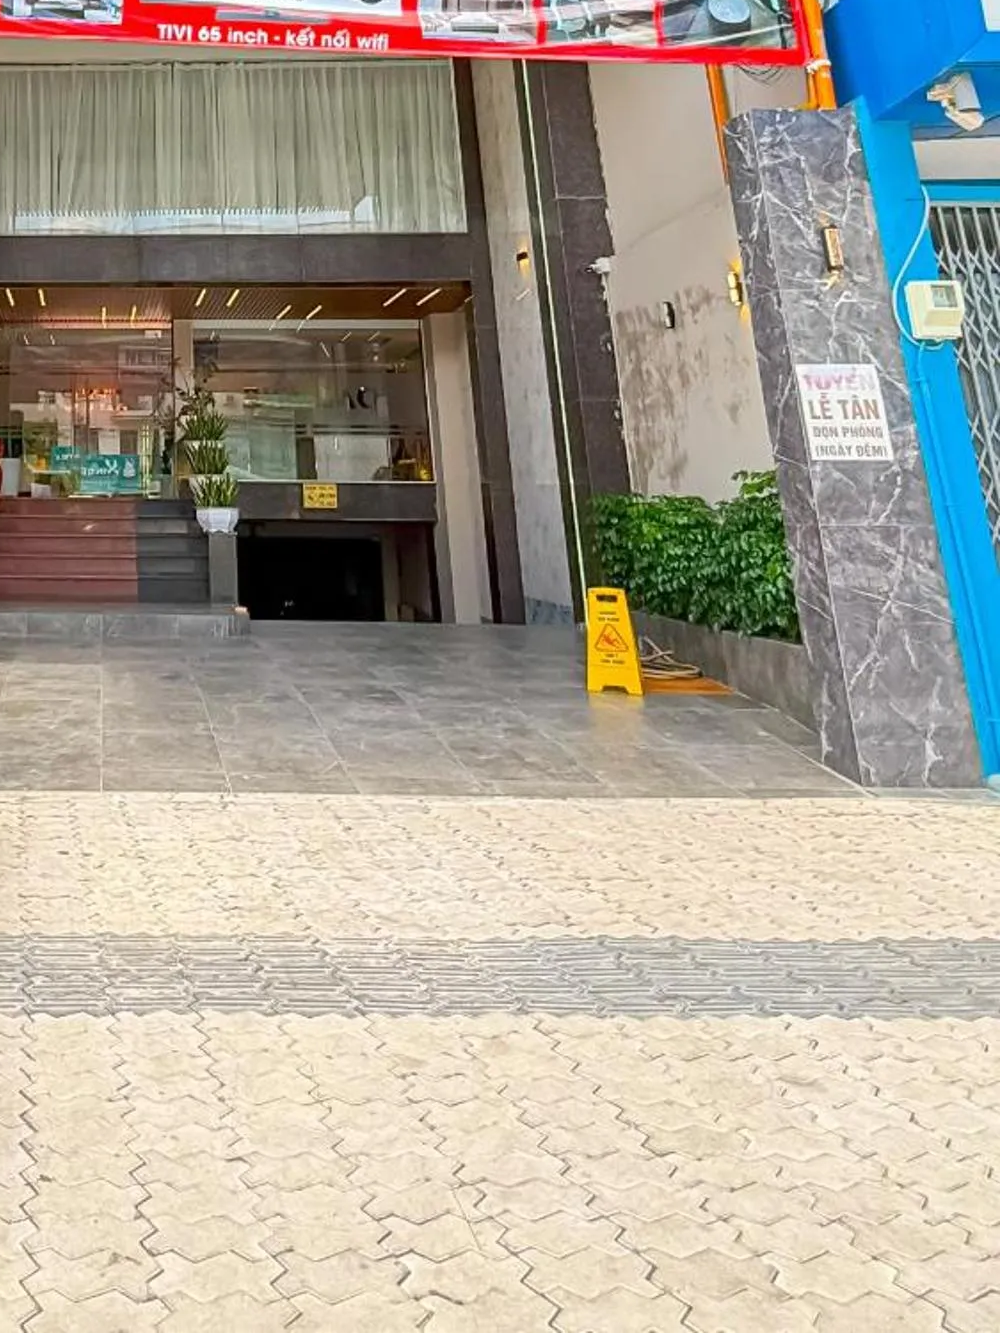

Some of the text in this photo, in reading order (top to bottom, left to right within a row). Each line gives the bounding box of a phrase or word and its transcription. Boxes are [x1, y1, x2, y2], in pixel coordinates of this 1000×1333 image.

[157, 24, 192, 41] TIVI
[198, 27, 221, 41] 65
[228, 27, 268, 44] inch
[286, 26, 316, 46] kết
[321, 26, 349, 48] nối
[357, 33, 389, 51] wifi
[808, 393, 880, 420] LỄ TÂN
